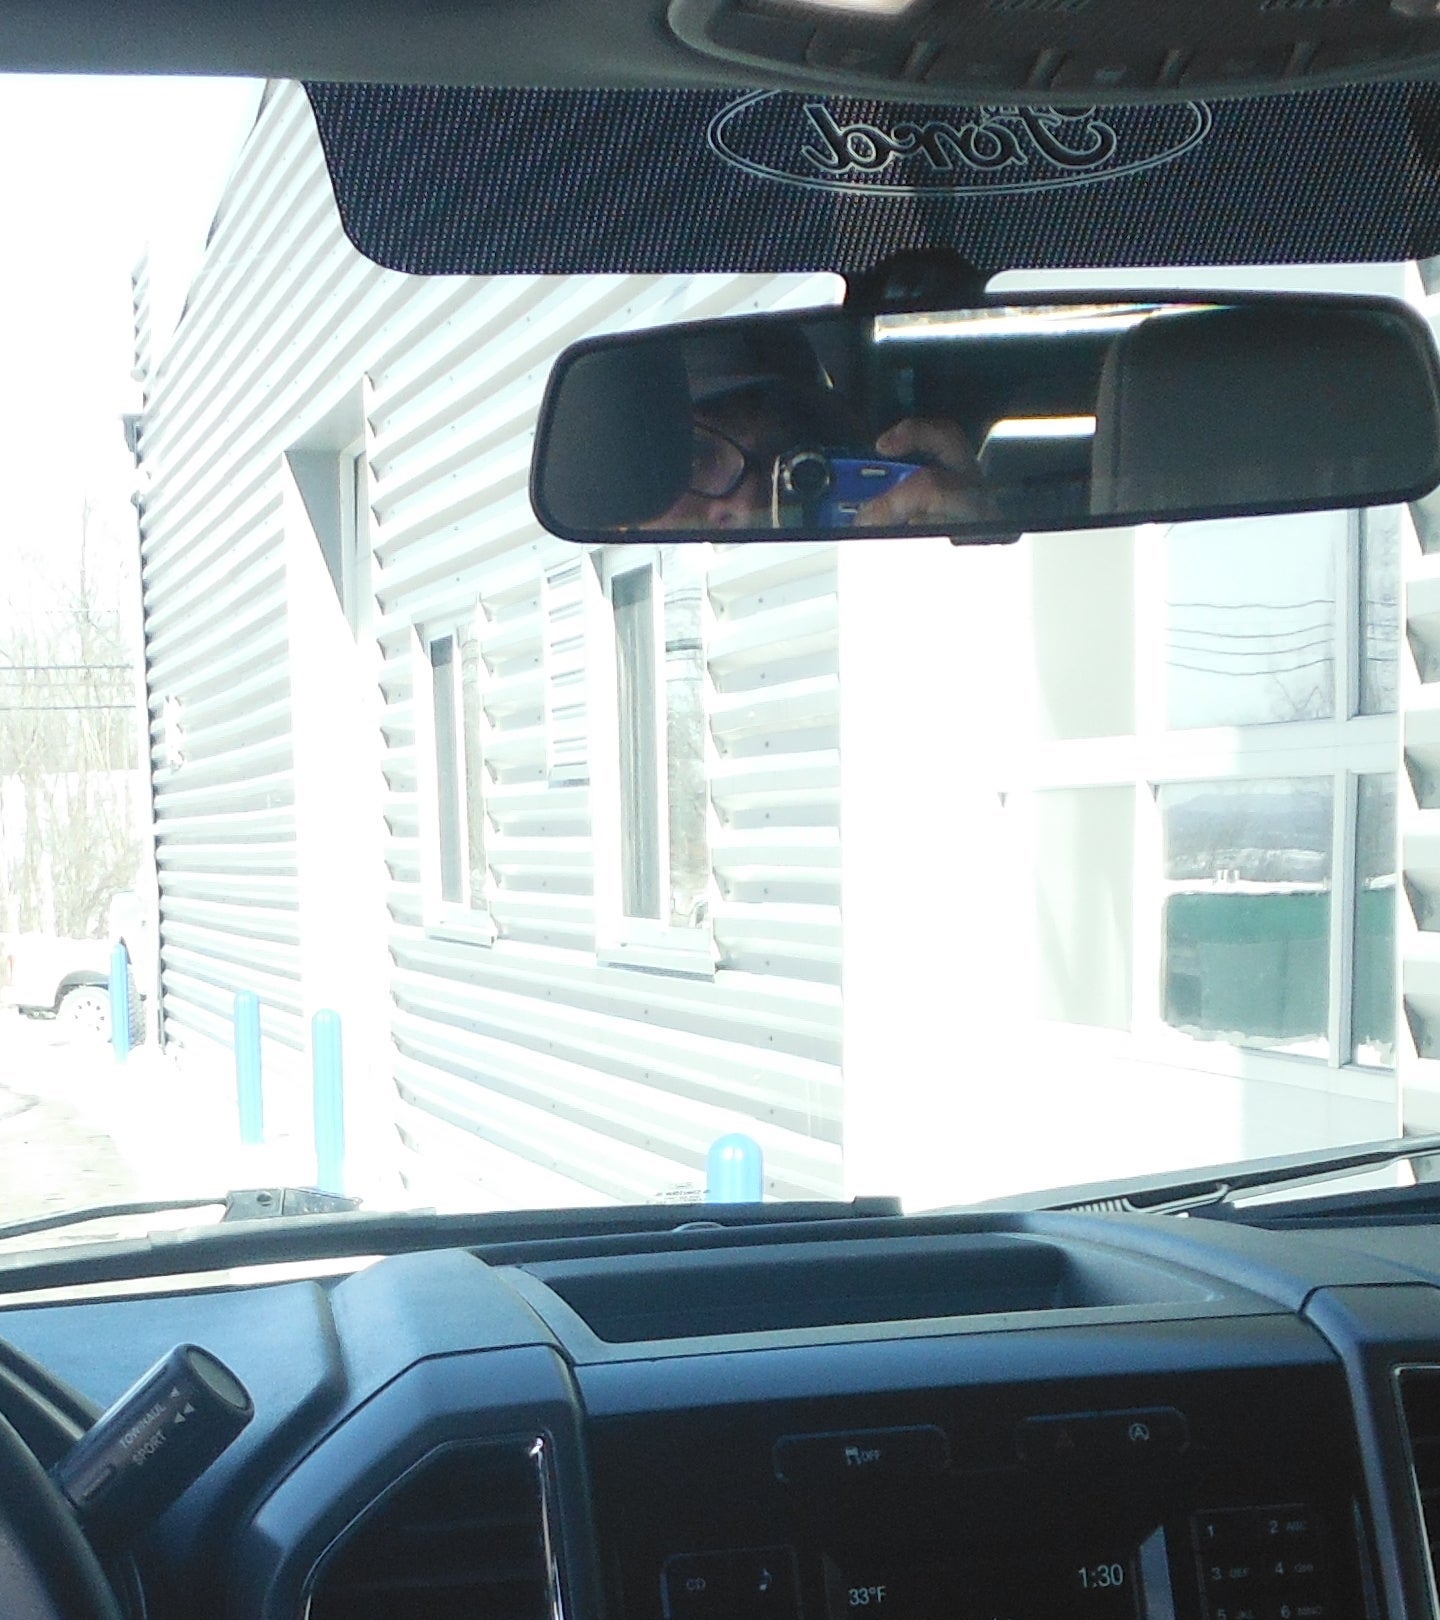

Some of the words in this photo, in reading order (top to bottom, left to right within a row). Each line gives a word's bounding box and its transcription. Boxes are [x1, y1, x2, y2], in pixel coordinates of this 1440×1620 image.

[133, 1429, 167, 1466] SPORT
[1268, 1519, 1280, 1535] 2
[1077, 1563, 1125, 1589] 1:30
[1210, 1565, 1223, 1581] 3
[1274, 1561, 1286, 1576] 4
[685, 1576, 707, 1592] CD
[1279, 1604, 1292, 1619] 6
